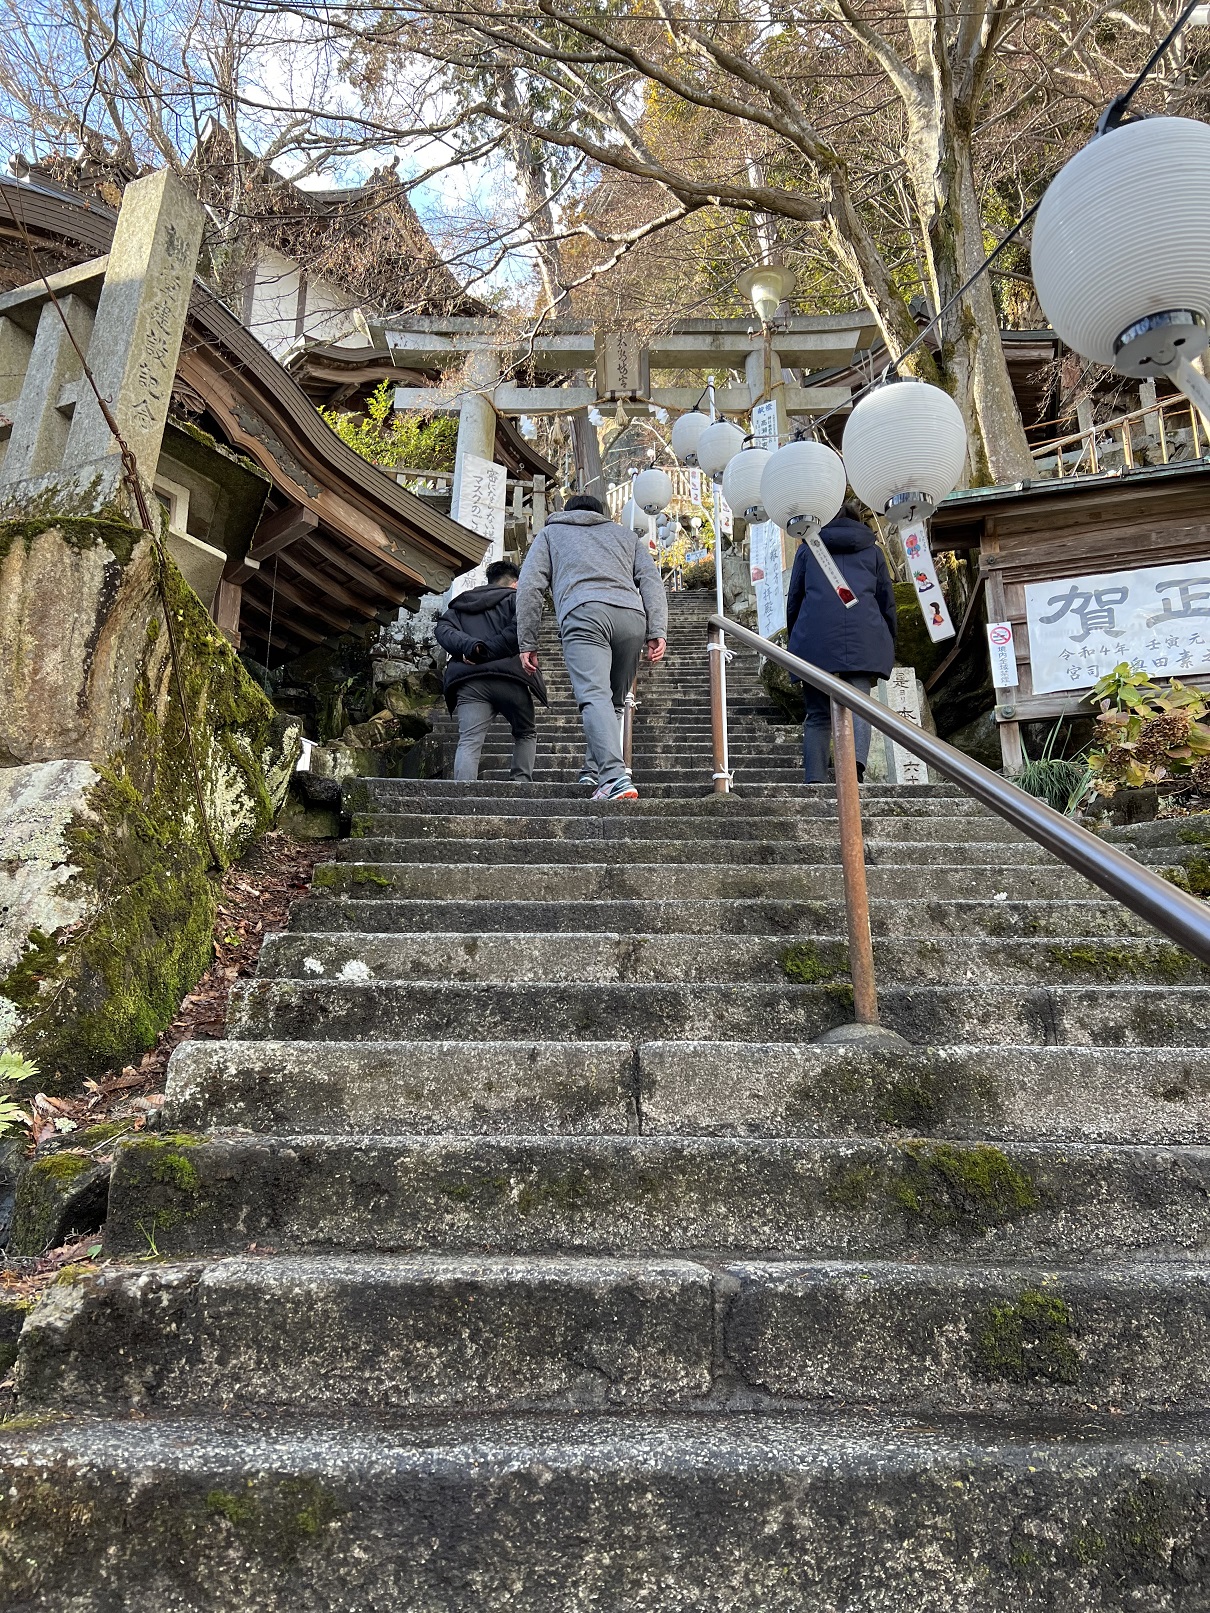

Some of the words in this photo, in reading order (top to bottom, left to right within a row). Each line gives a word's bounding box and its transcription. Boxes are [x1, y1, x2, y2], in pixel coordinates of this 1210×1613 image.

[1038, 577, 1210, 643] 賀正
[1058, 642, 1130, 661] 令和4年
[1066, 664, 1100, 681] 宮司
